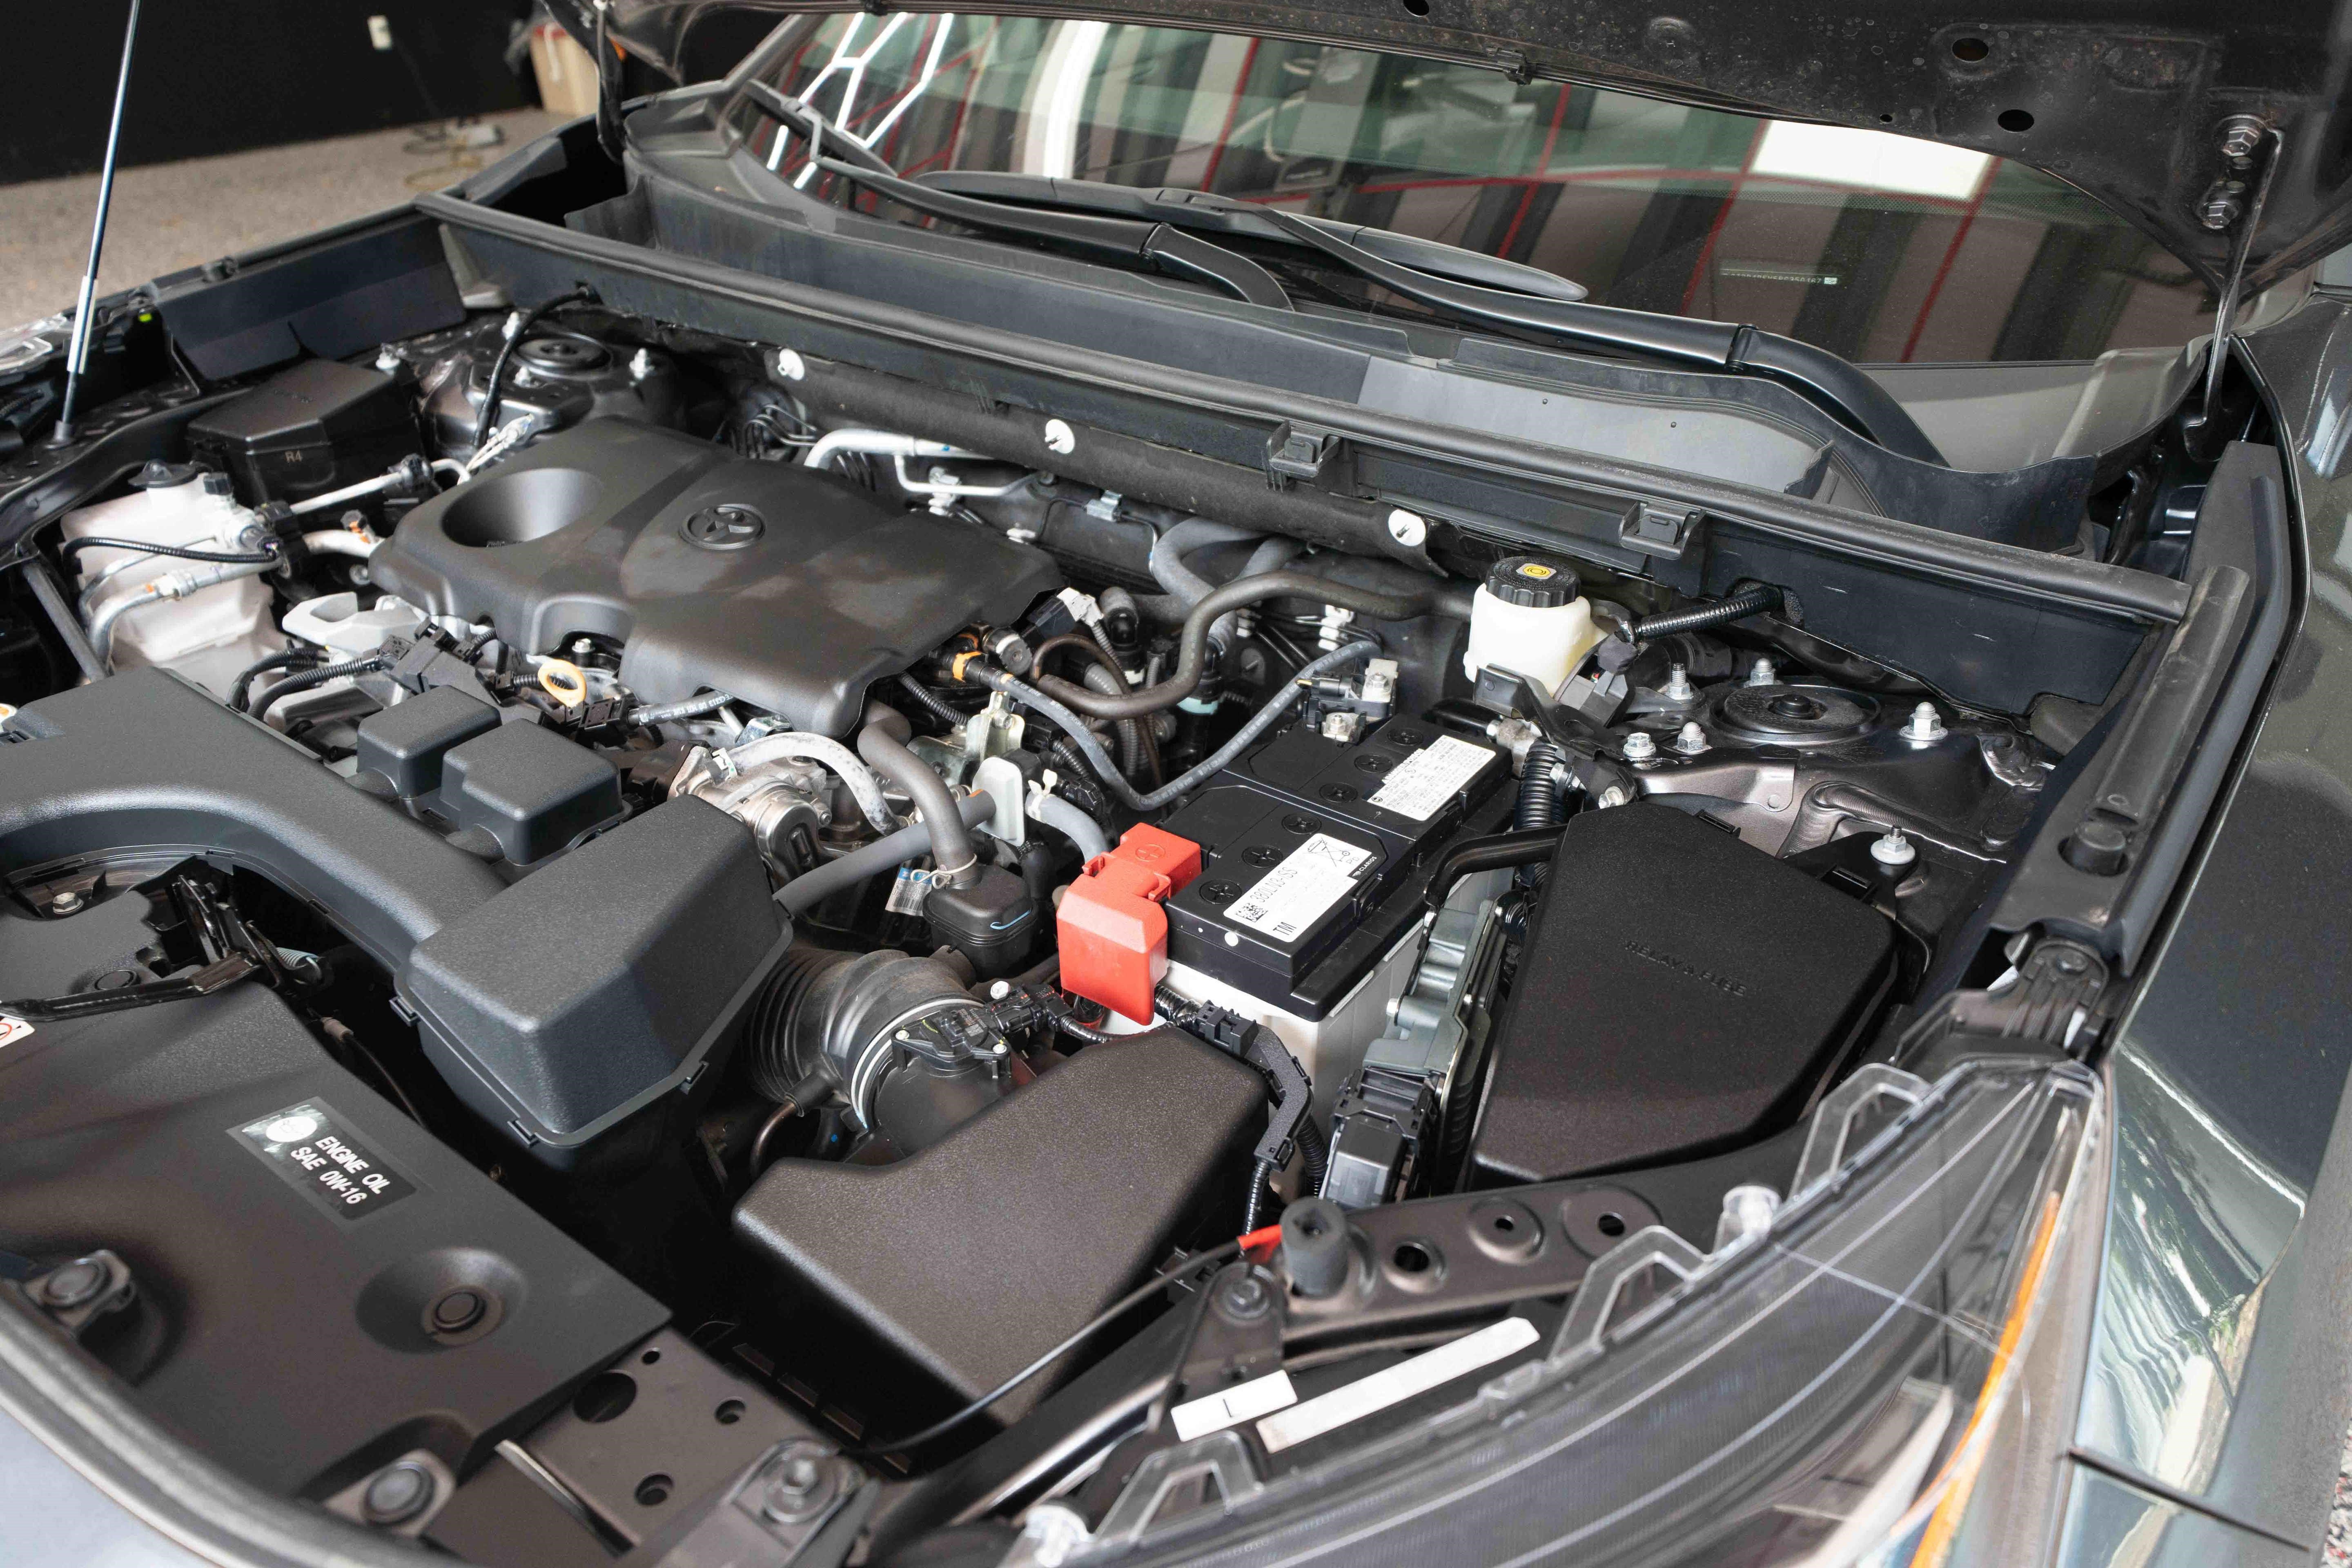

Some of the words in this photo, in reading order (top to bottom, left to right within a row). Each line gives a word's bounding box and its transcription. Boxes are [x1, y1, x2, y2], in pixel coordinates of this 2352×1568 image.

[285, 450, 303, 463] R4
[1359, 856, 1377, 871] CLARIOS
[1272, 922, 1297, 935] TM
[315, 1136, 369, 1174] ENGINE
[362, 1173, 391, 1194] OIL
[291, 1146, 327, 1171] SAE
[319, 1170, 368, 1205] 0W-16
